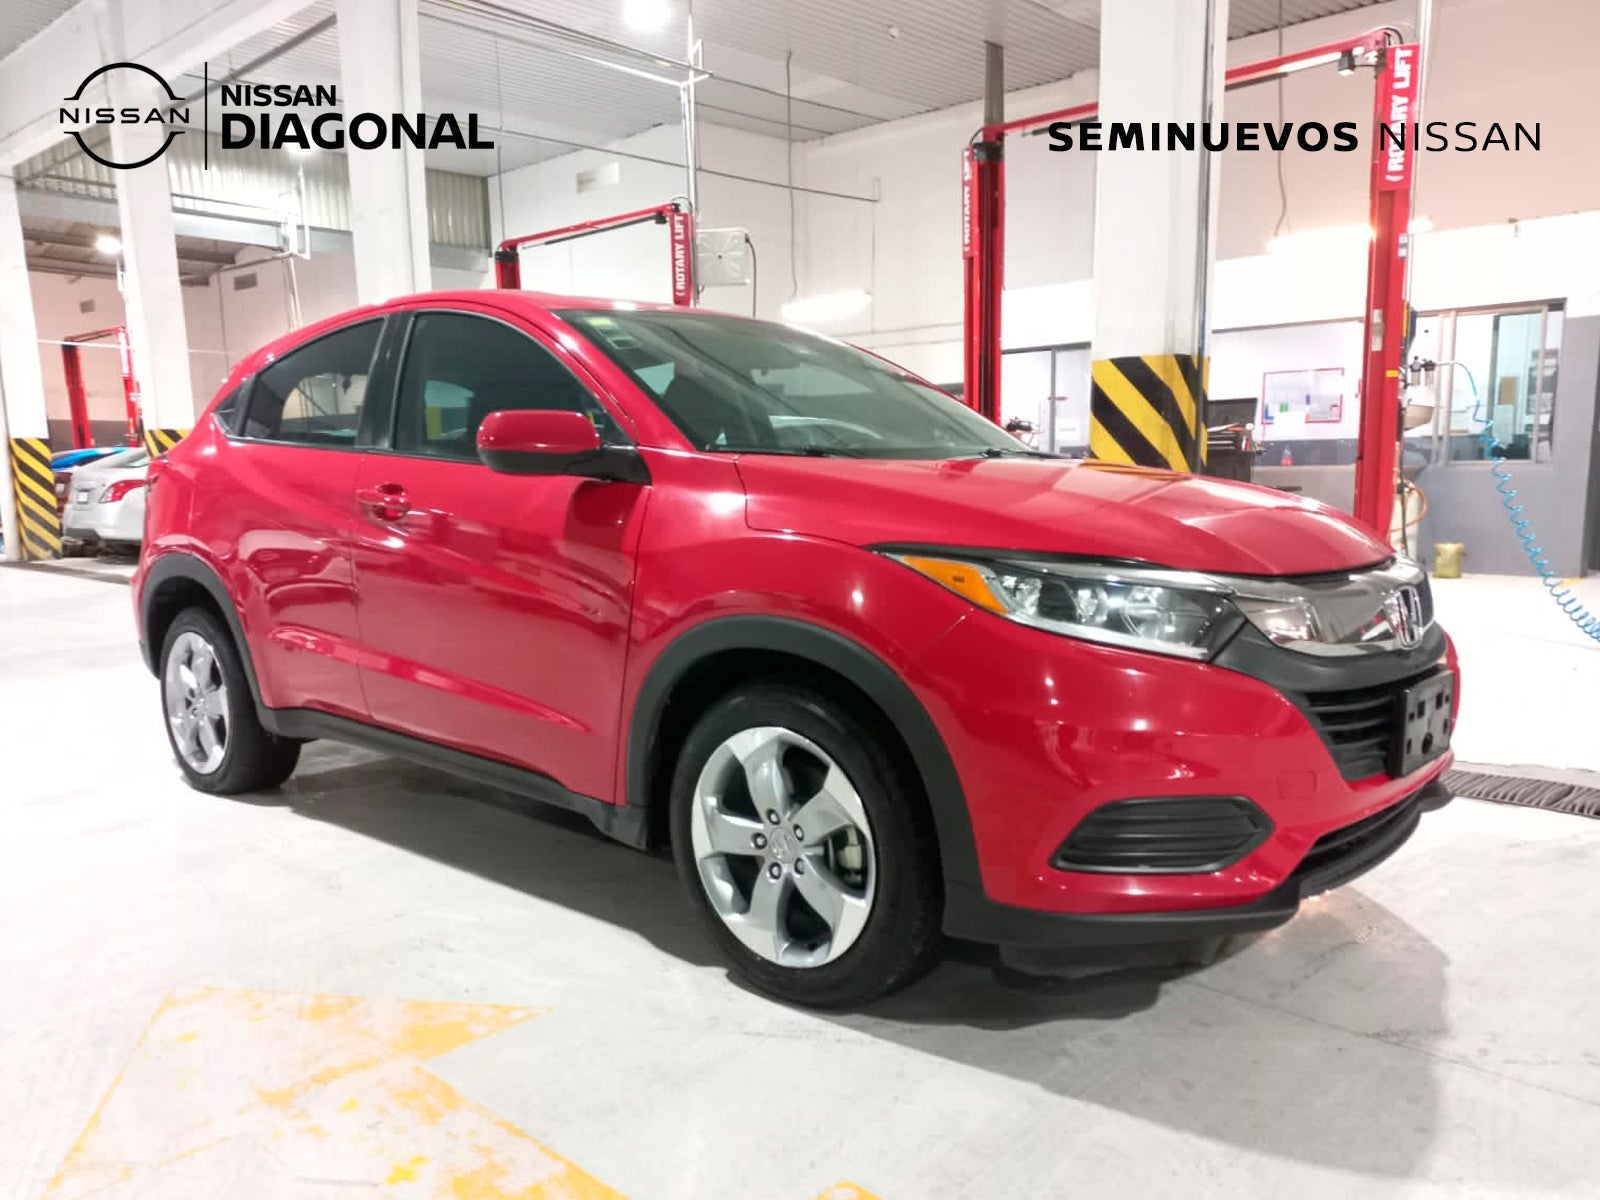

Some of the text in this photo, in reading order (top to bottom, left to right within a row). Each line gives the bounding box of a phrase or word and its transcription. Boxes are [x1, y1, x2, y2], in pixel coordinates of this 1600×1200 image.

[1393, 48, 1412, 89] LIFT
[674, 214, 686, 290] ROTARY LIFT
